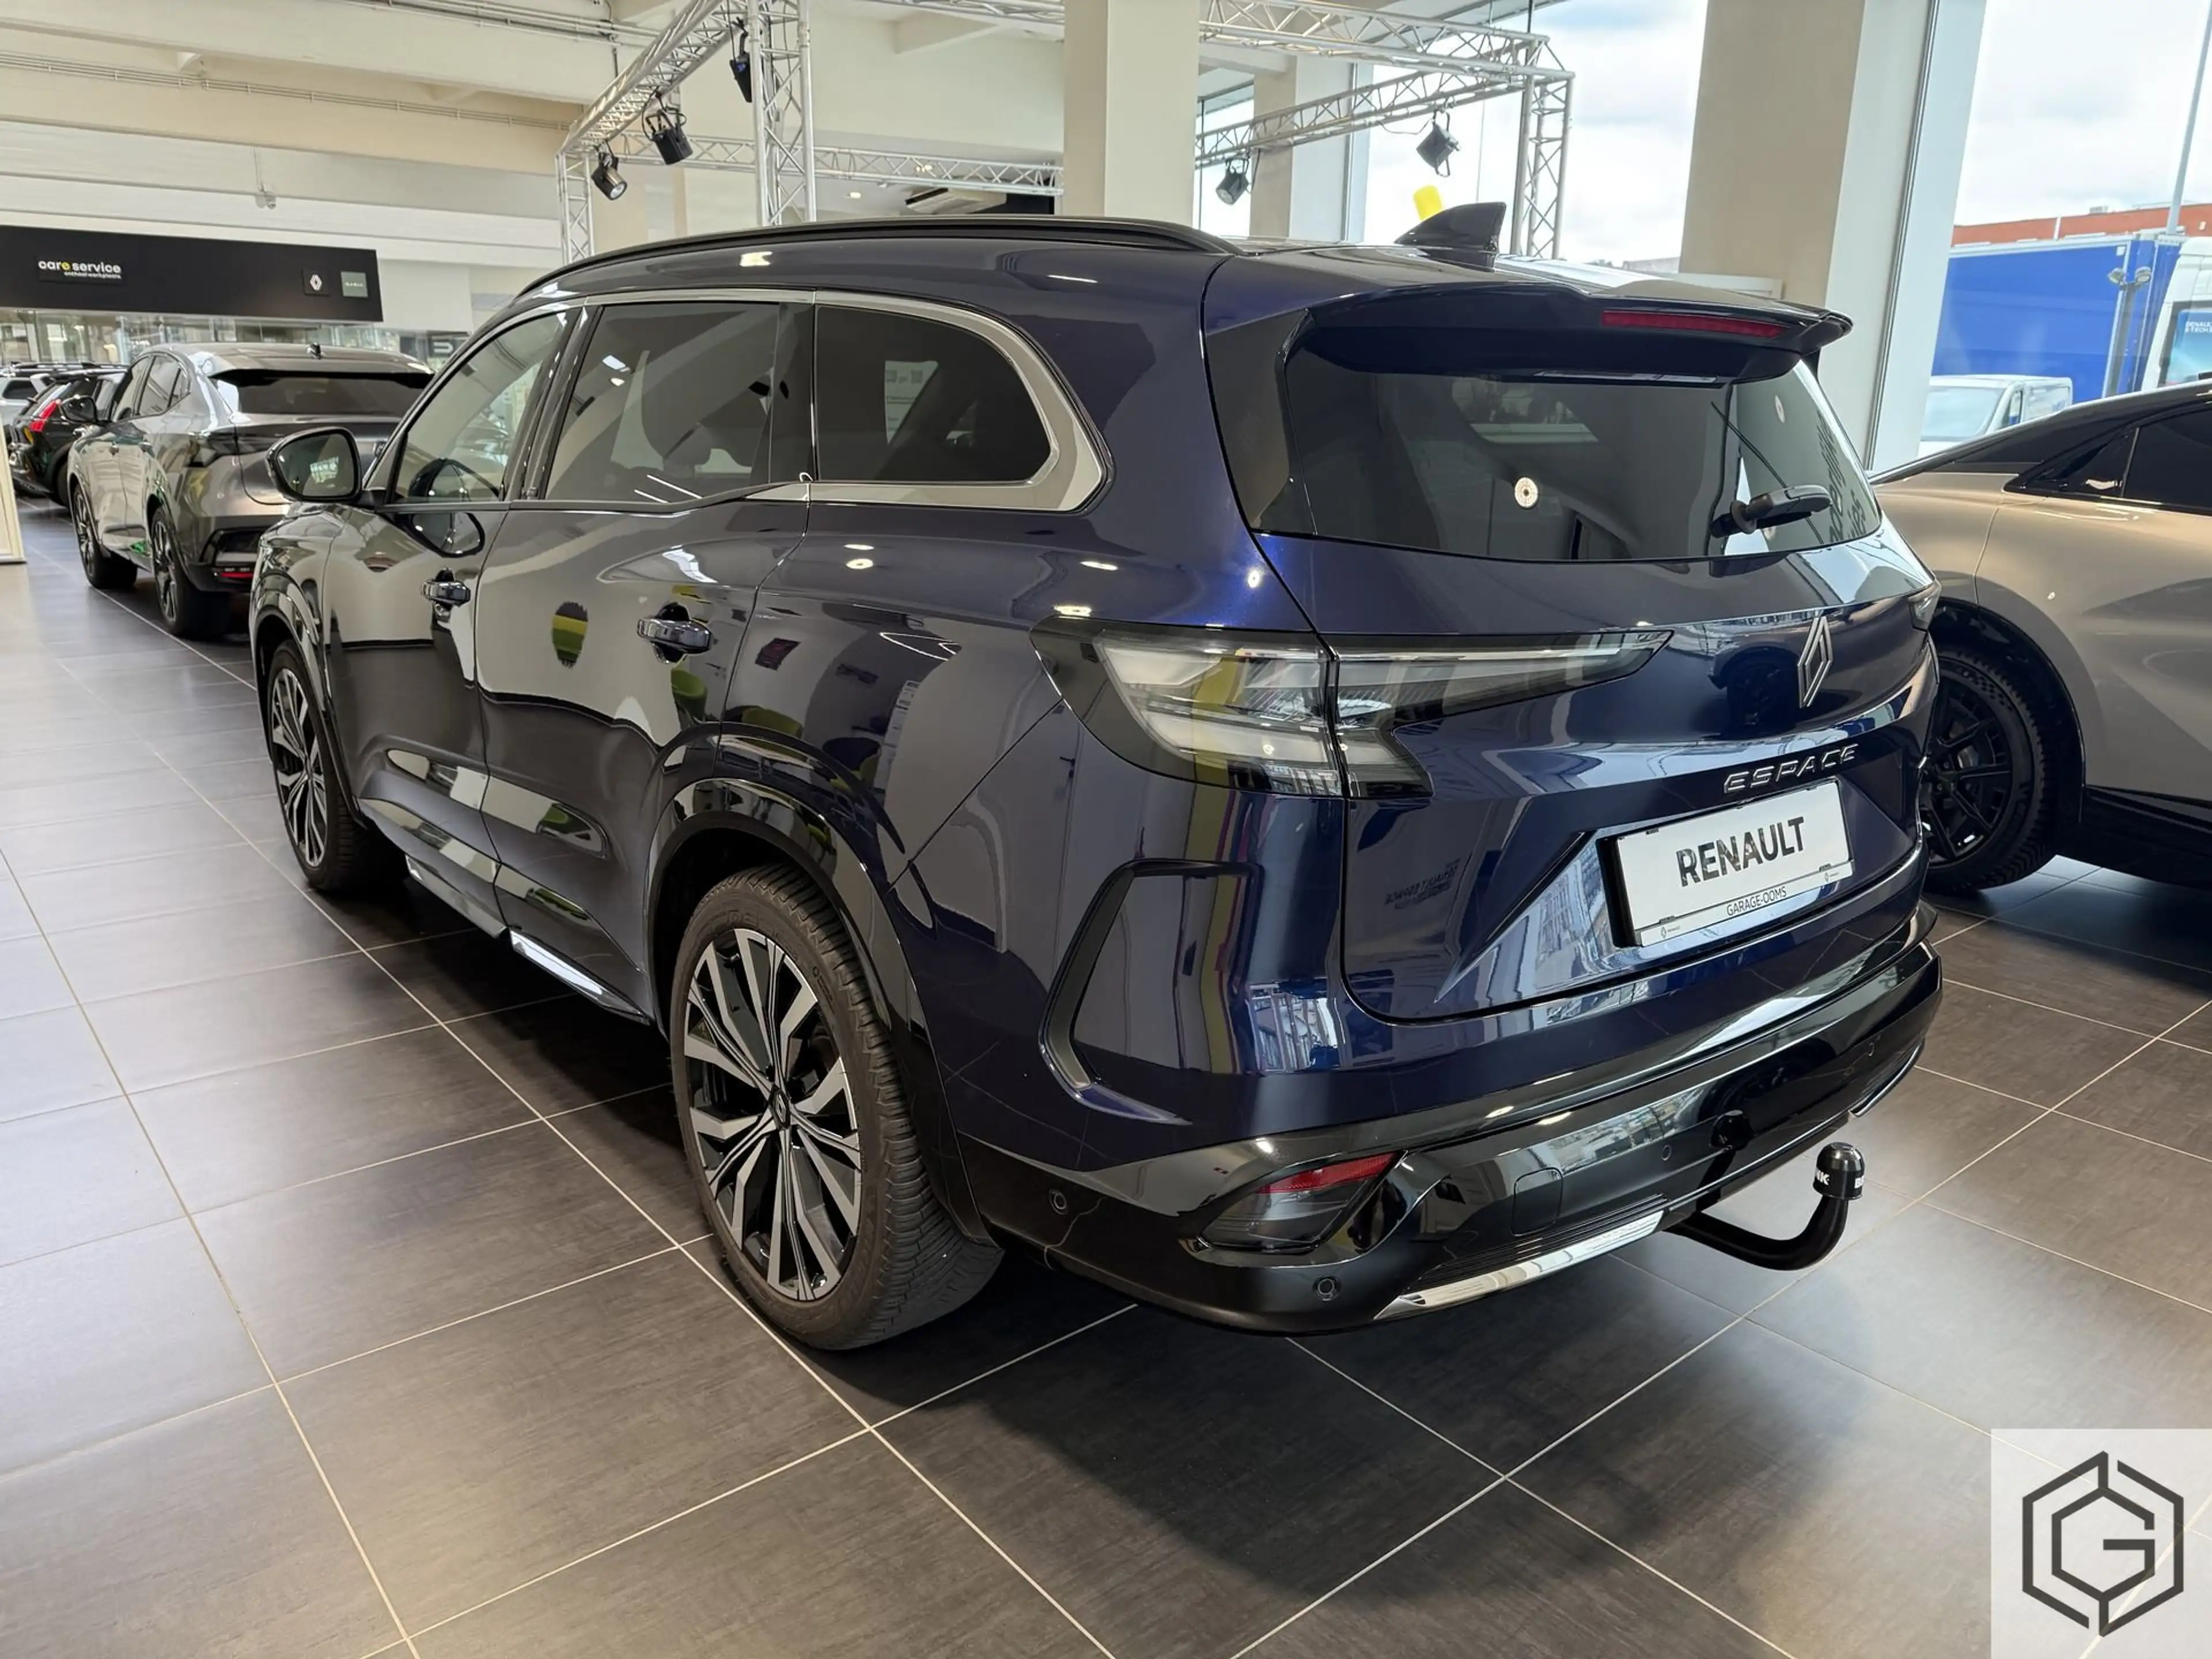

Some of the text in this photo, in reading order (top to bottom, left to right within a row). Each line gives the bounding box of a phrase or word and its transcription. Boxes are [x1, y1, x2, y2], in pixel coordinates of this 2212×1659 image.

[1724, 744, 1859, 793] ESPACE
[1676, 816, 1804, 887] RENAULT
[1726, 886, 1787, 916] GARAGE-OOMS
